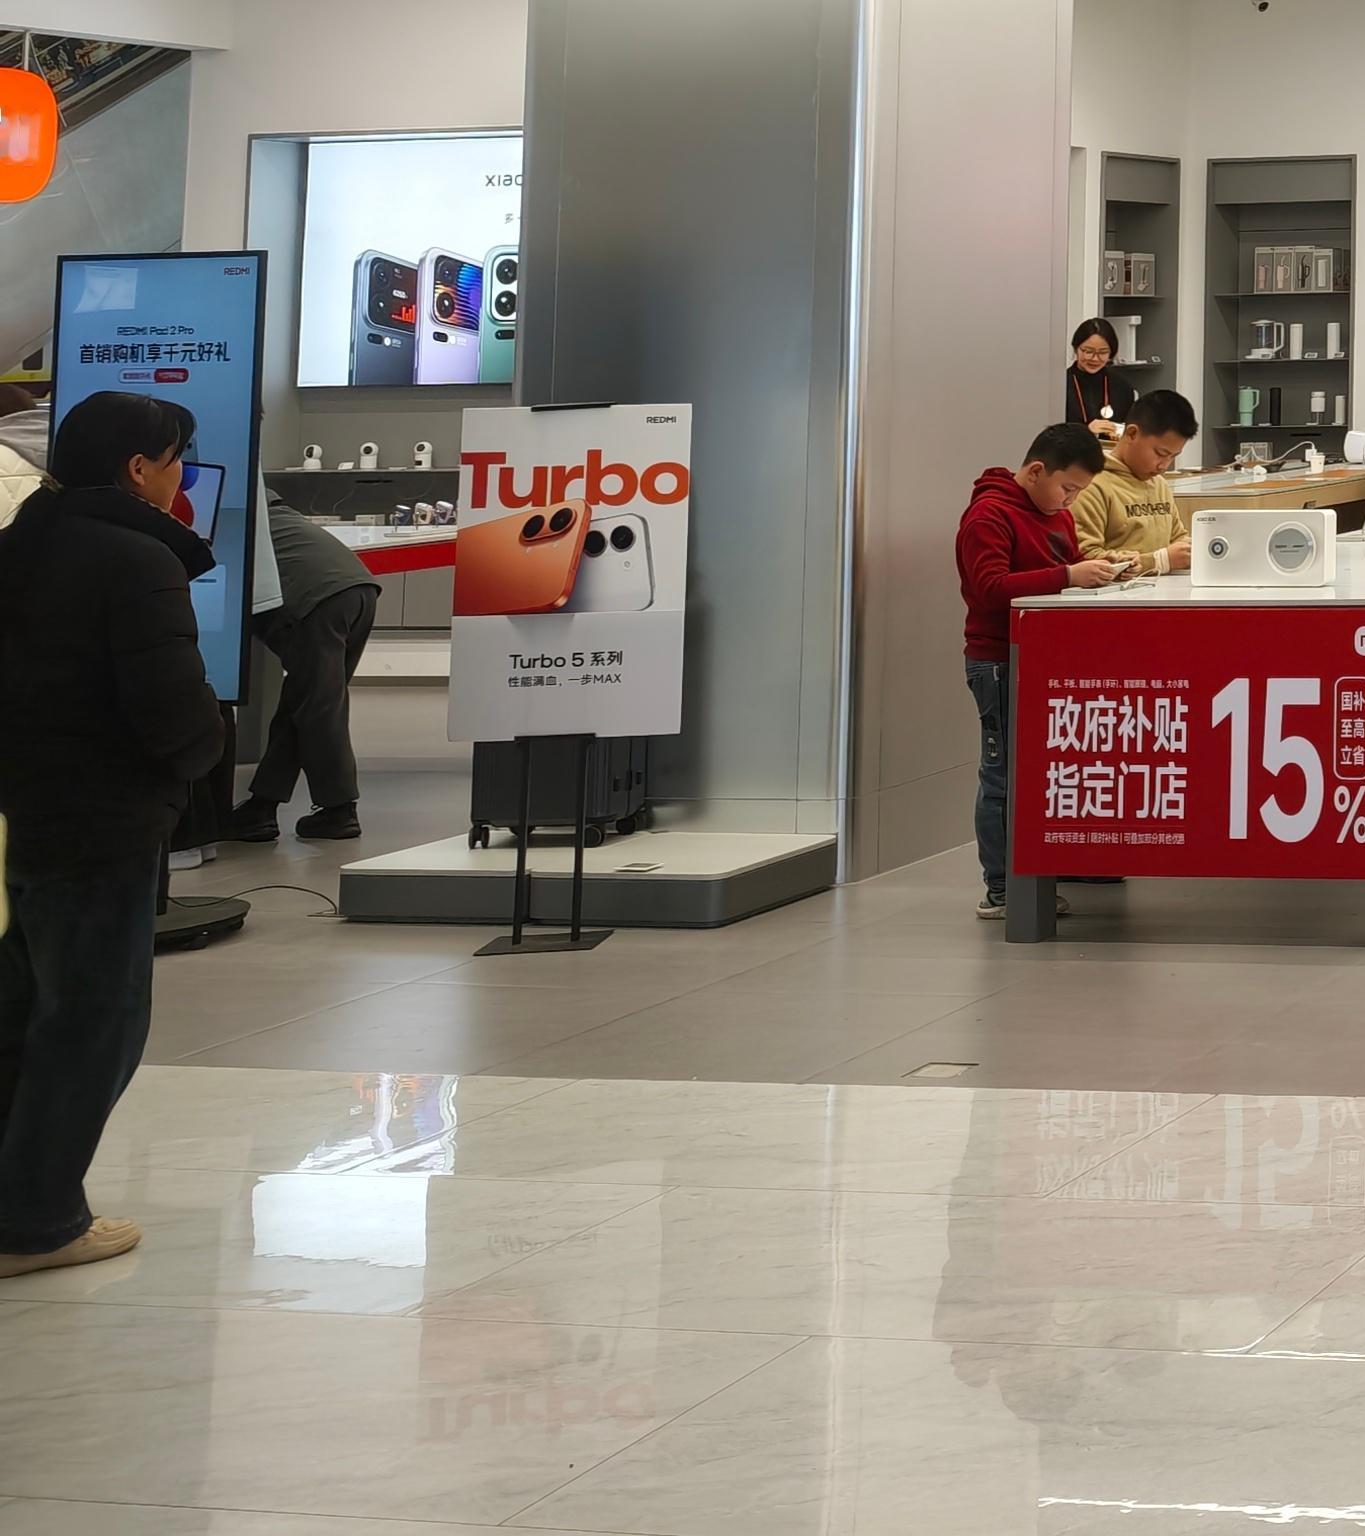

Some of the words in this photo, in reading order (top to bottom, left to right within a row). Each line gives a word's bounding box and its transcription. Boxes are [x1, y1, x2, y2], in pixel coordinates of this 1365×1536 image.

[223, 267, 250, 276] REDMI
[117, 326, 148, 336] REDMI
[149, 325, 169, 336] Pad
[169, 326, 177, 336] 2
[178, 325, 194, 335] Pro
[79, 340, 232, 364] 首销购机享千元好礼
[646, 416, 676, 424] REDMI
[460, 448, 689, 509] Turbo
[508, 653, 566, 670] Turbo
[571, 652, 585, 667] 5
[590, 650, 623, 667] 系列
[1340, 691, 1365, 713] 国补
[1046, 695, 1188, 754] 政府补贴
[1340, 717, 1365, 739] 至高
[1211, 677, 1324, 843] 15
[1340, 745, 1365, 766] 立省
[1045, 761, 1188, 820] 指定门店
